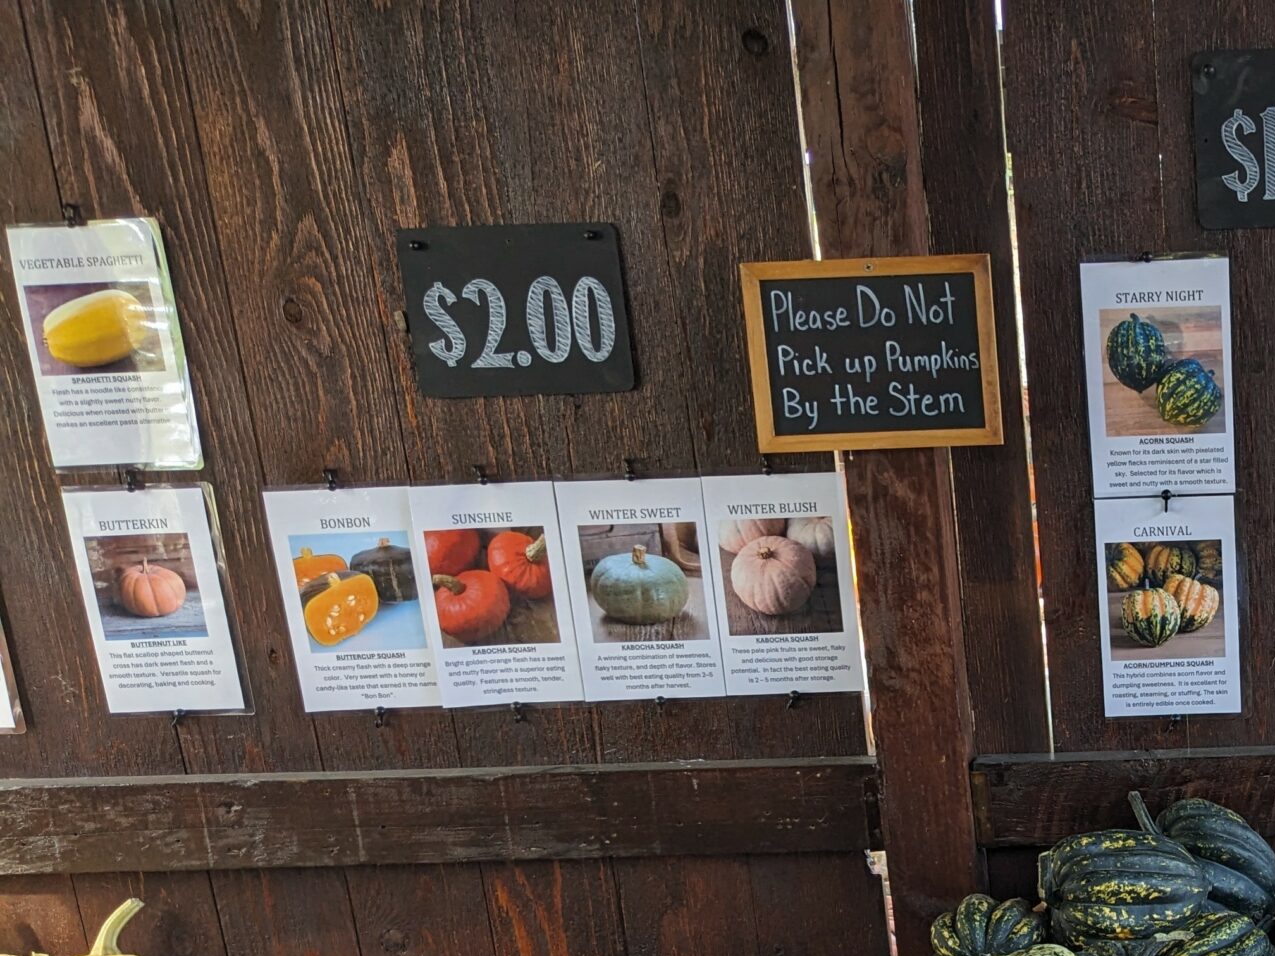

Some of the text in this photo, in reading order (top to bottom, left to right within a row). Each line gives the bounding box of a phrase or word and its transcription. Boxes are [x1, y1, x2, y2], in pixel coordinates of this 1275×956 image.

[20, 255, 143, 270] VEGETABLE SPAGHETTI
[1116, 290, 1204, 304] STARRY NIGHT
[771, 282, 956, 332] Please Do Not
[423, 276, 616, 369] $2.00
[778, 344, 980, 382] Pick up Pumpkins
[72, 375, 142, 384] SPAGHETTI SQUASH
[783, 383, 965, 429] By the Stem
[1139, 437, 1164, 445] ACORN
[589, 507, 681, 520] WINTER SWEET
[728, 502, 817, 515] WINTER BLUSH
[320, 517, 371, 529] BONBON
[452, 512, 513, 524] SUNSHINE
[99, 518, 168, 531] BUTTERKIN
[1133, 526, 1192, 537] CARNIVAL
[336, 652, 405, 661] BUTTERCUP SQUASH
[472, 646, 536, 655] KABOCHA SQUASH
[332, 664, 355, 672] creamy
[393, 662, 408, 670] deep
[409, 661, 431, 669] orange
[1123, 660, 1214, 669] ACORN/DUMPLING SQUASH
[1132, 700, 1154, 708] entirely
